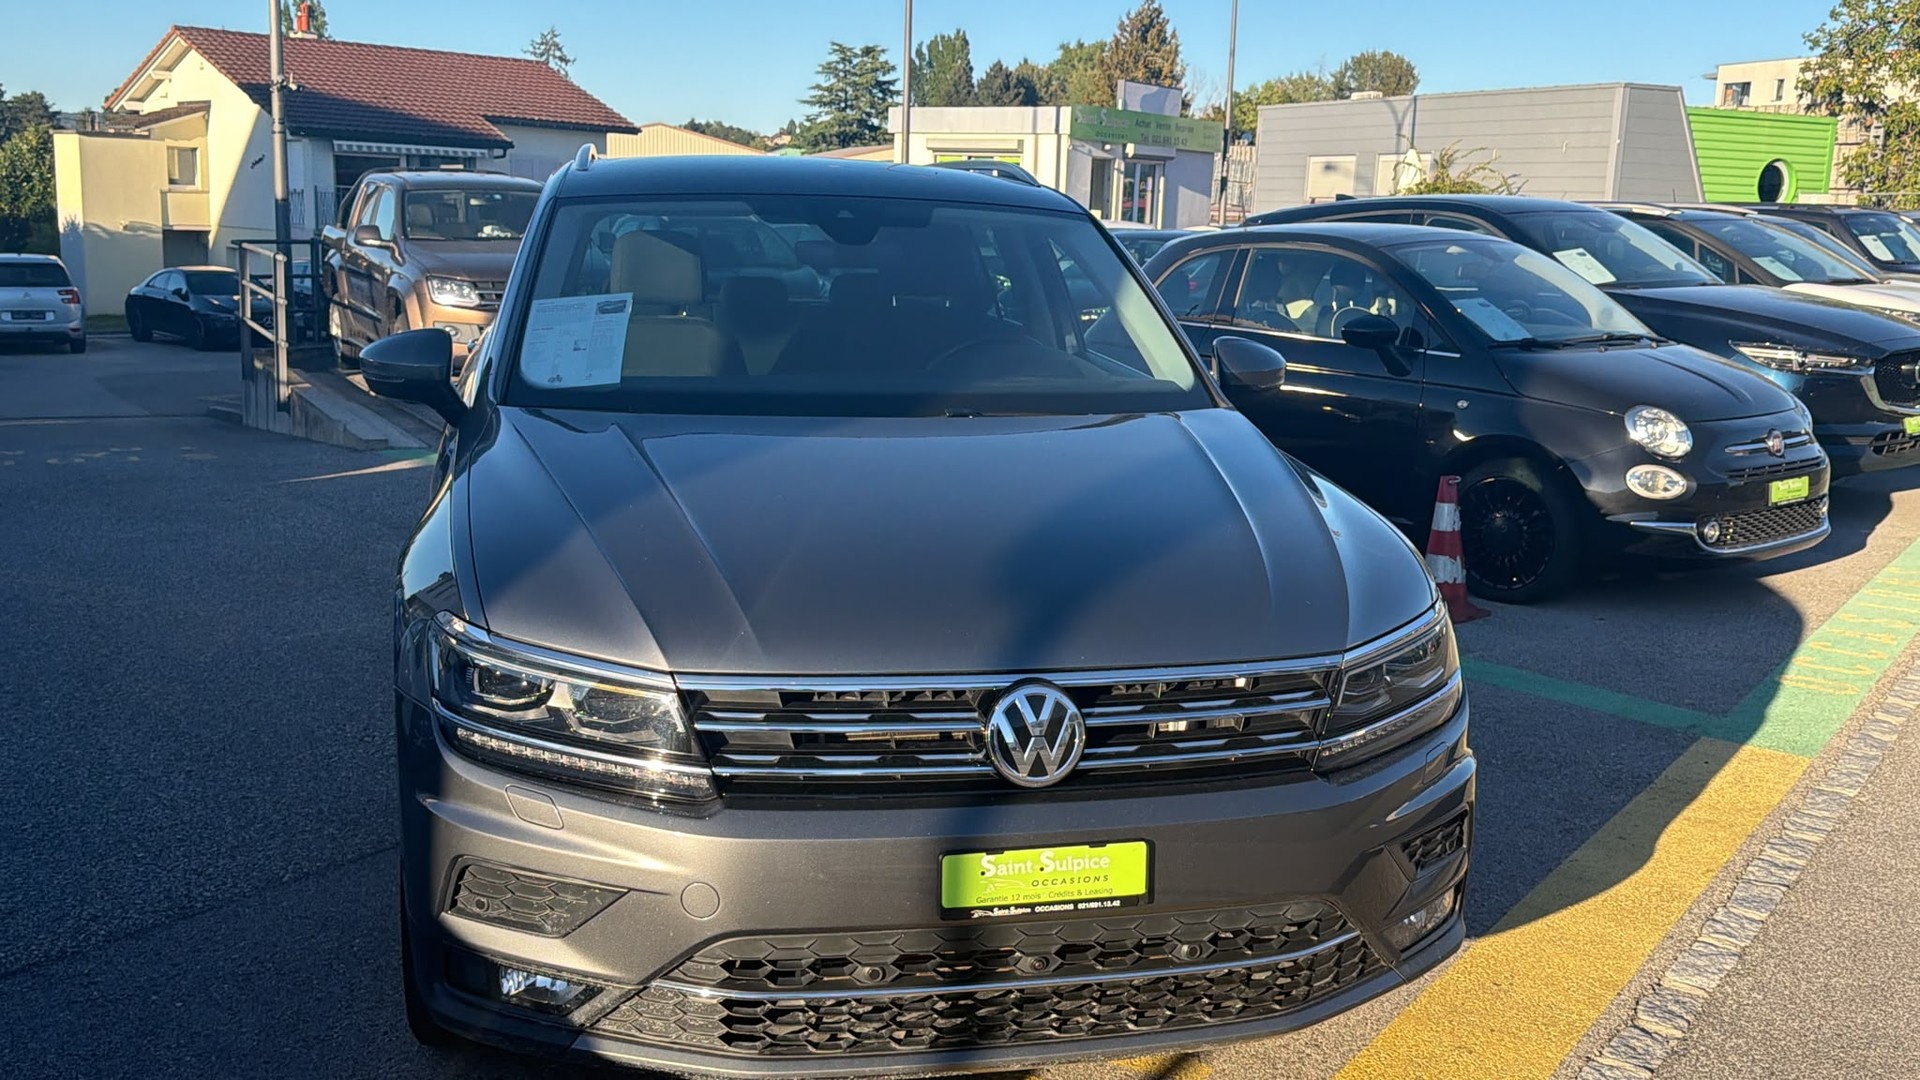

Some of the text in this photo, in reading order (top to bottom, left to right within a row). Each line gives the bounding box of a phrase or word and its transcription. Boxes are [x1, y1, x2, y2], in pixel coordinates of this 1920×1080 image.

[988, 685, 1083, 785] VW
[1031, 874, 1109, 887] OCCASIONS
[976, 887, 1113, 904] Garantie 12 mois Crédits & Leasing
[1035, 903, 1074, 913] OCCASIONS
